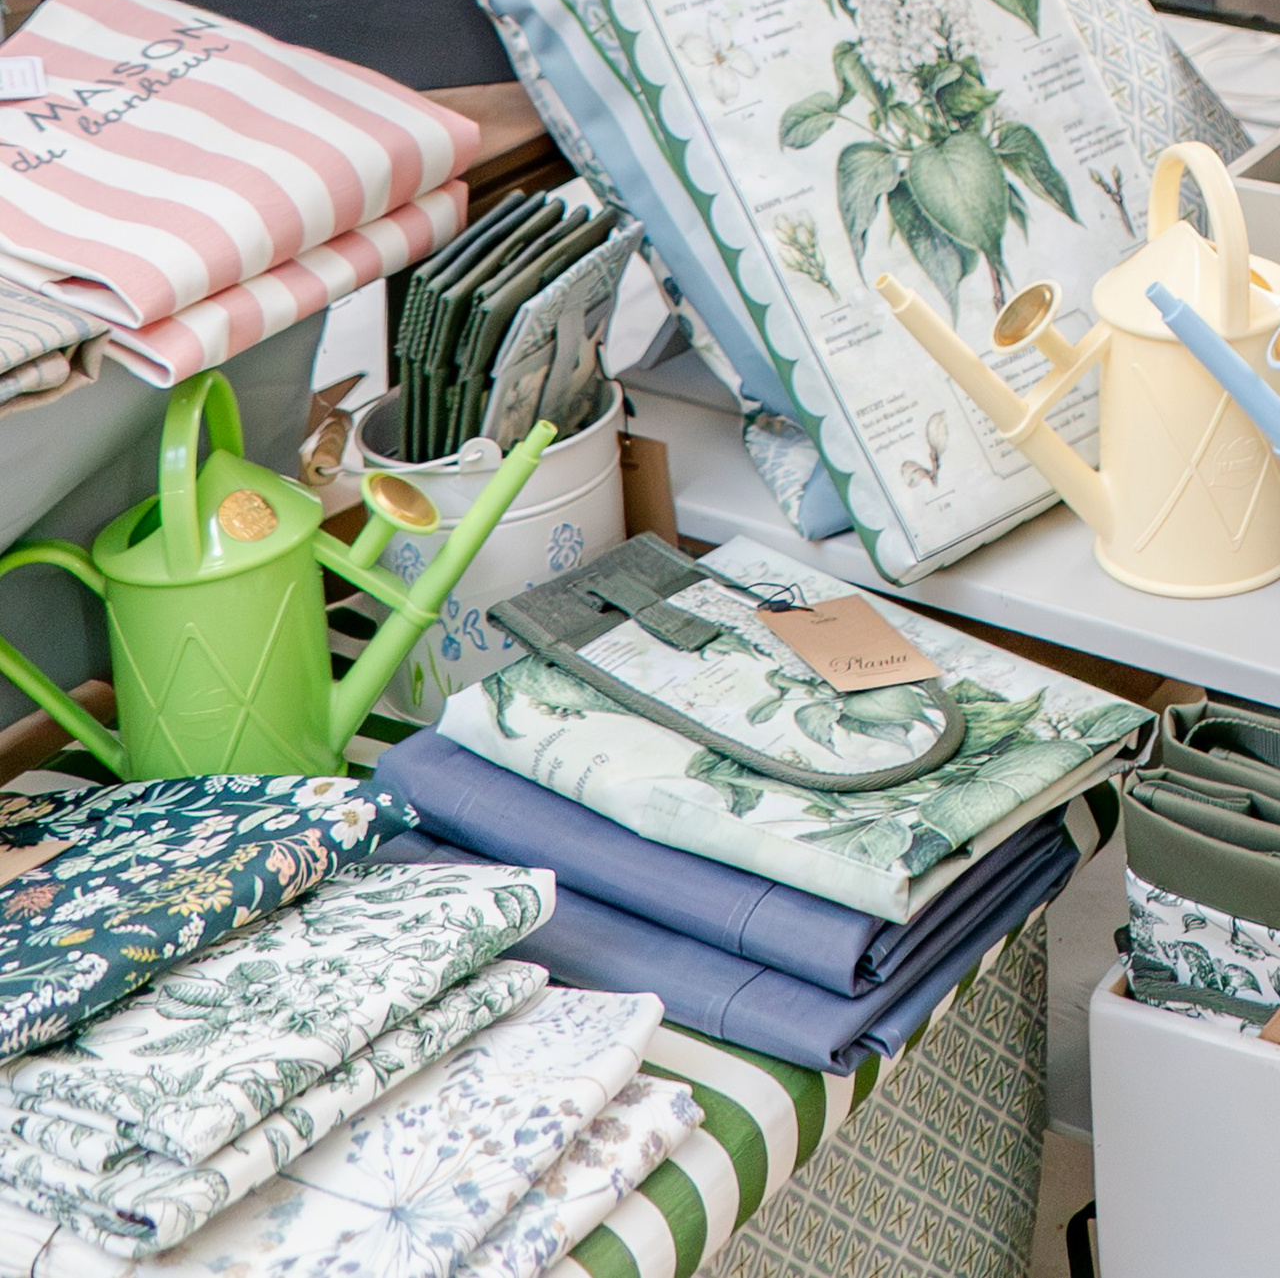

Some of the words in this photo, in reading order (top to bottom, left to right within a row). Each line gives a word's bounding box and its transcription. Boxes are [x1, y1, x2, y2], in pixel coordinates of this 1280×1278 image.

[11, 148, 68, 173] du
[77, 43, 230, 136] bonheur
[23, 17, 222, 133] MAISON
[829, 653, 909, 674] Planta
